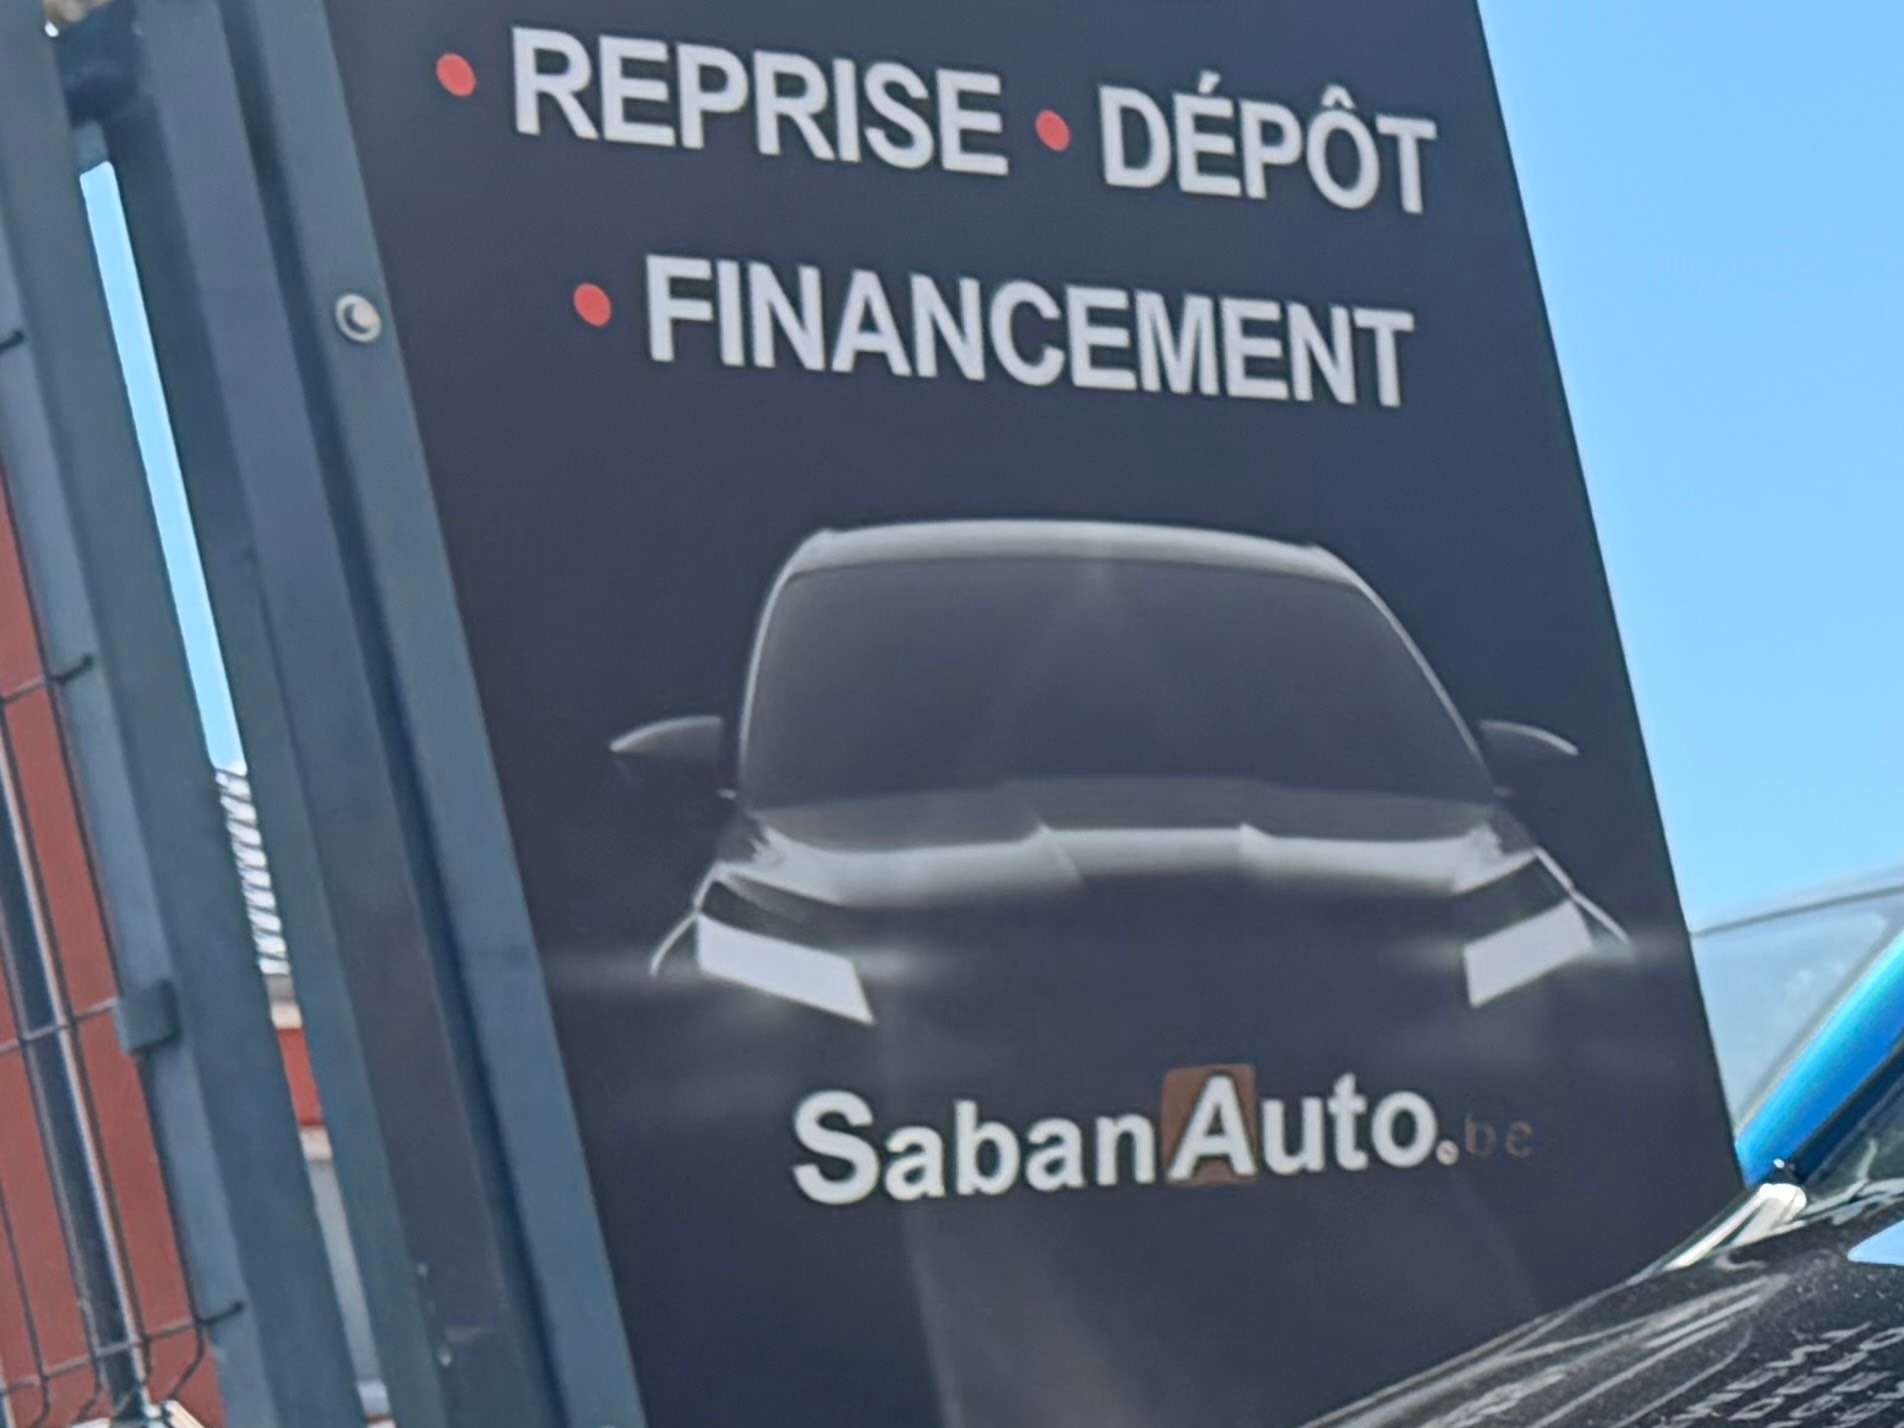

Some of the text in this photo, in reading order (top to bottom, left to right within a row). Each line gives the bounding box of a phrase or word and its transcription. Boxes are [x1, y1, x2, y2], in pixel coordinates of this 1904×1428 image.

[511, 26, 1438, 214] REPRISE DÉPÔT
[645, 253, 1416, 408] FINANCEMENT
